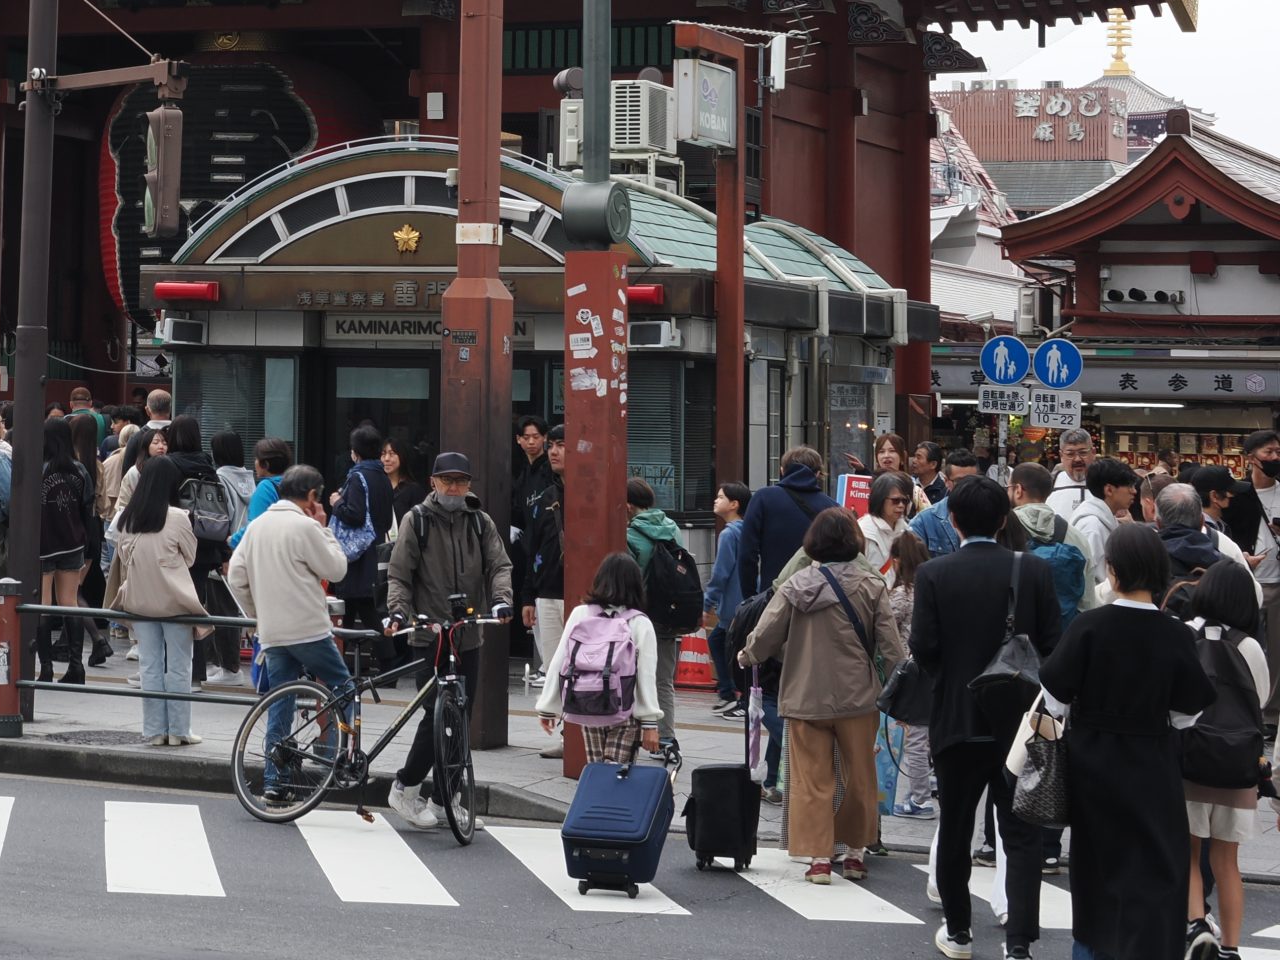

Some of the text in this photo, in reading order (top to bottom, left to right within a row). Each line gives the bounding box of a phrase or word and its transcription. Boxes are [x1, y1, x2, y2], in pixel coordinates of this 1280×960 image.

[699, 111, 727, 132] KOBAN
[335, 320, 442, 336] KAMINARIMO
[1119, 372, 1234, 392] 表参道
[982, 390, 1025, 401] 自転車を除く
[1035, 393, 1056, 403] 自転車
[982, 401, 1025, 413] 仲見世通り
[1035, 403, 1056, 413] 人力車
